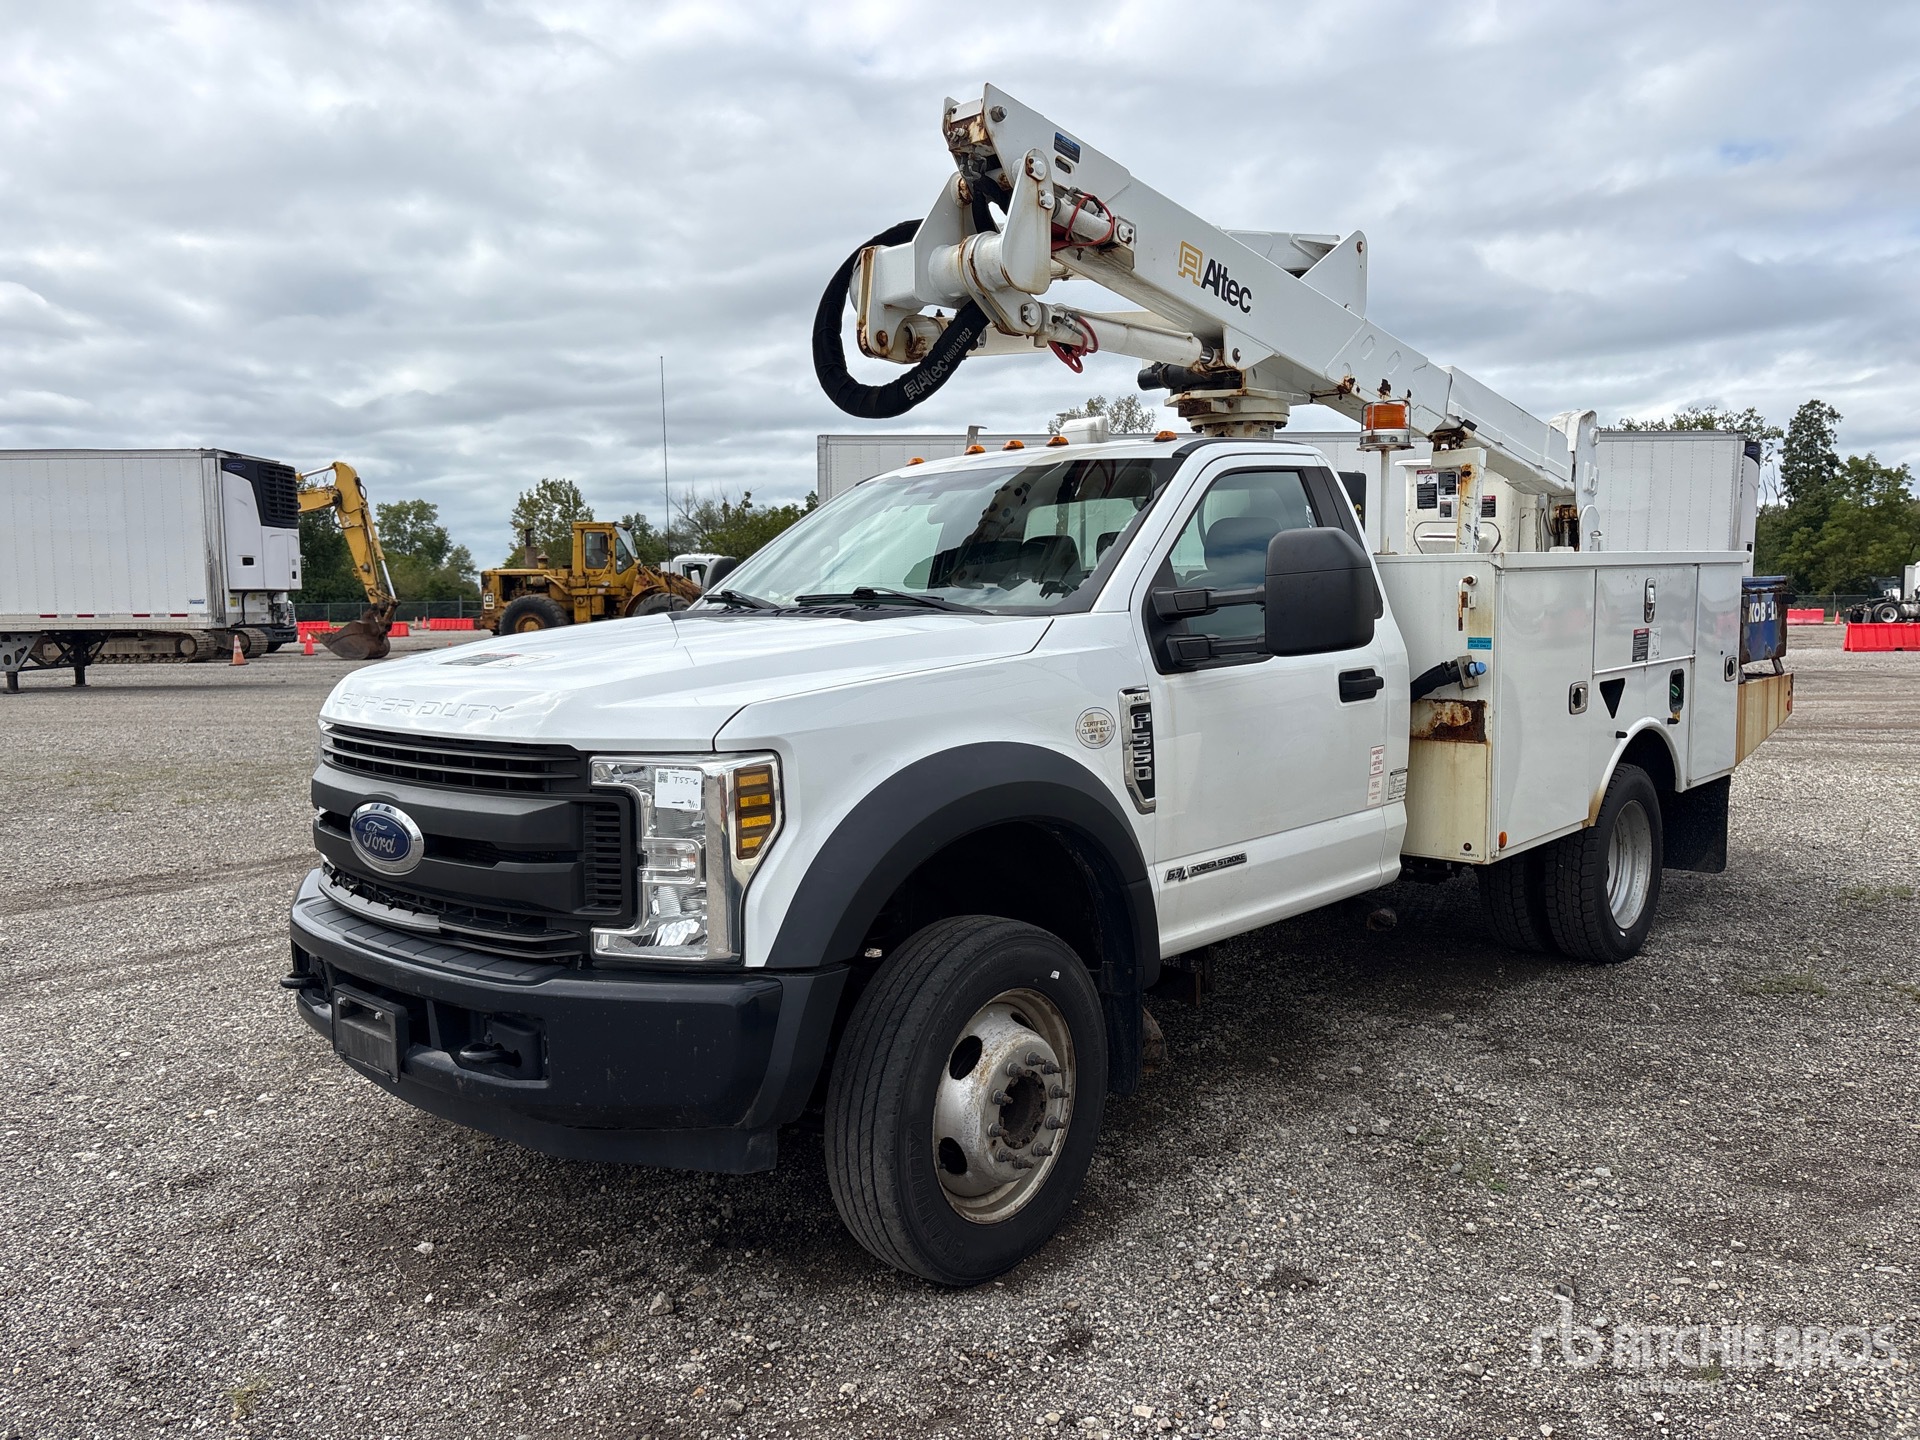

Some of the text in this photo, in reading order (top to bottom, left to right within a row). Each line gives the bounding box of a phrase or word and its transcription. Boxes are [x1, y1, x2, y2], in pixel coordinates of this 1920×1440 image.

[1201, 258, 1252, 314] Altec
[916, 327, 973, 392] Altec 060213022
[337, 692, 515, 721] SUPER DUTY
[1081, 725, 1110, 735] CLEAN IDLE
[1083, 719, 1108, 728] CERTIFIED
[362, 820, 397, 854] Ford
[1190, 860, 1217, 874] POWER
[1217, 852, 1246, 867] STROKE
